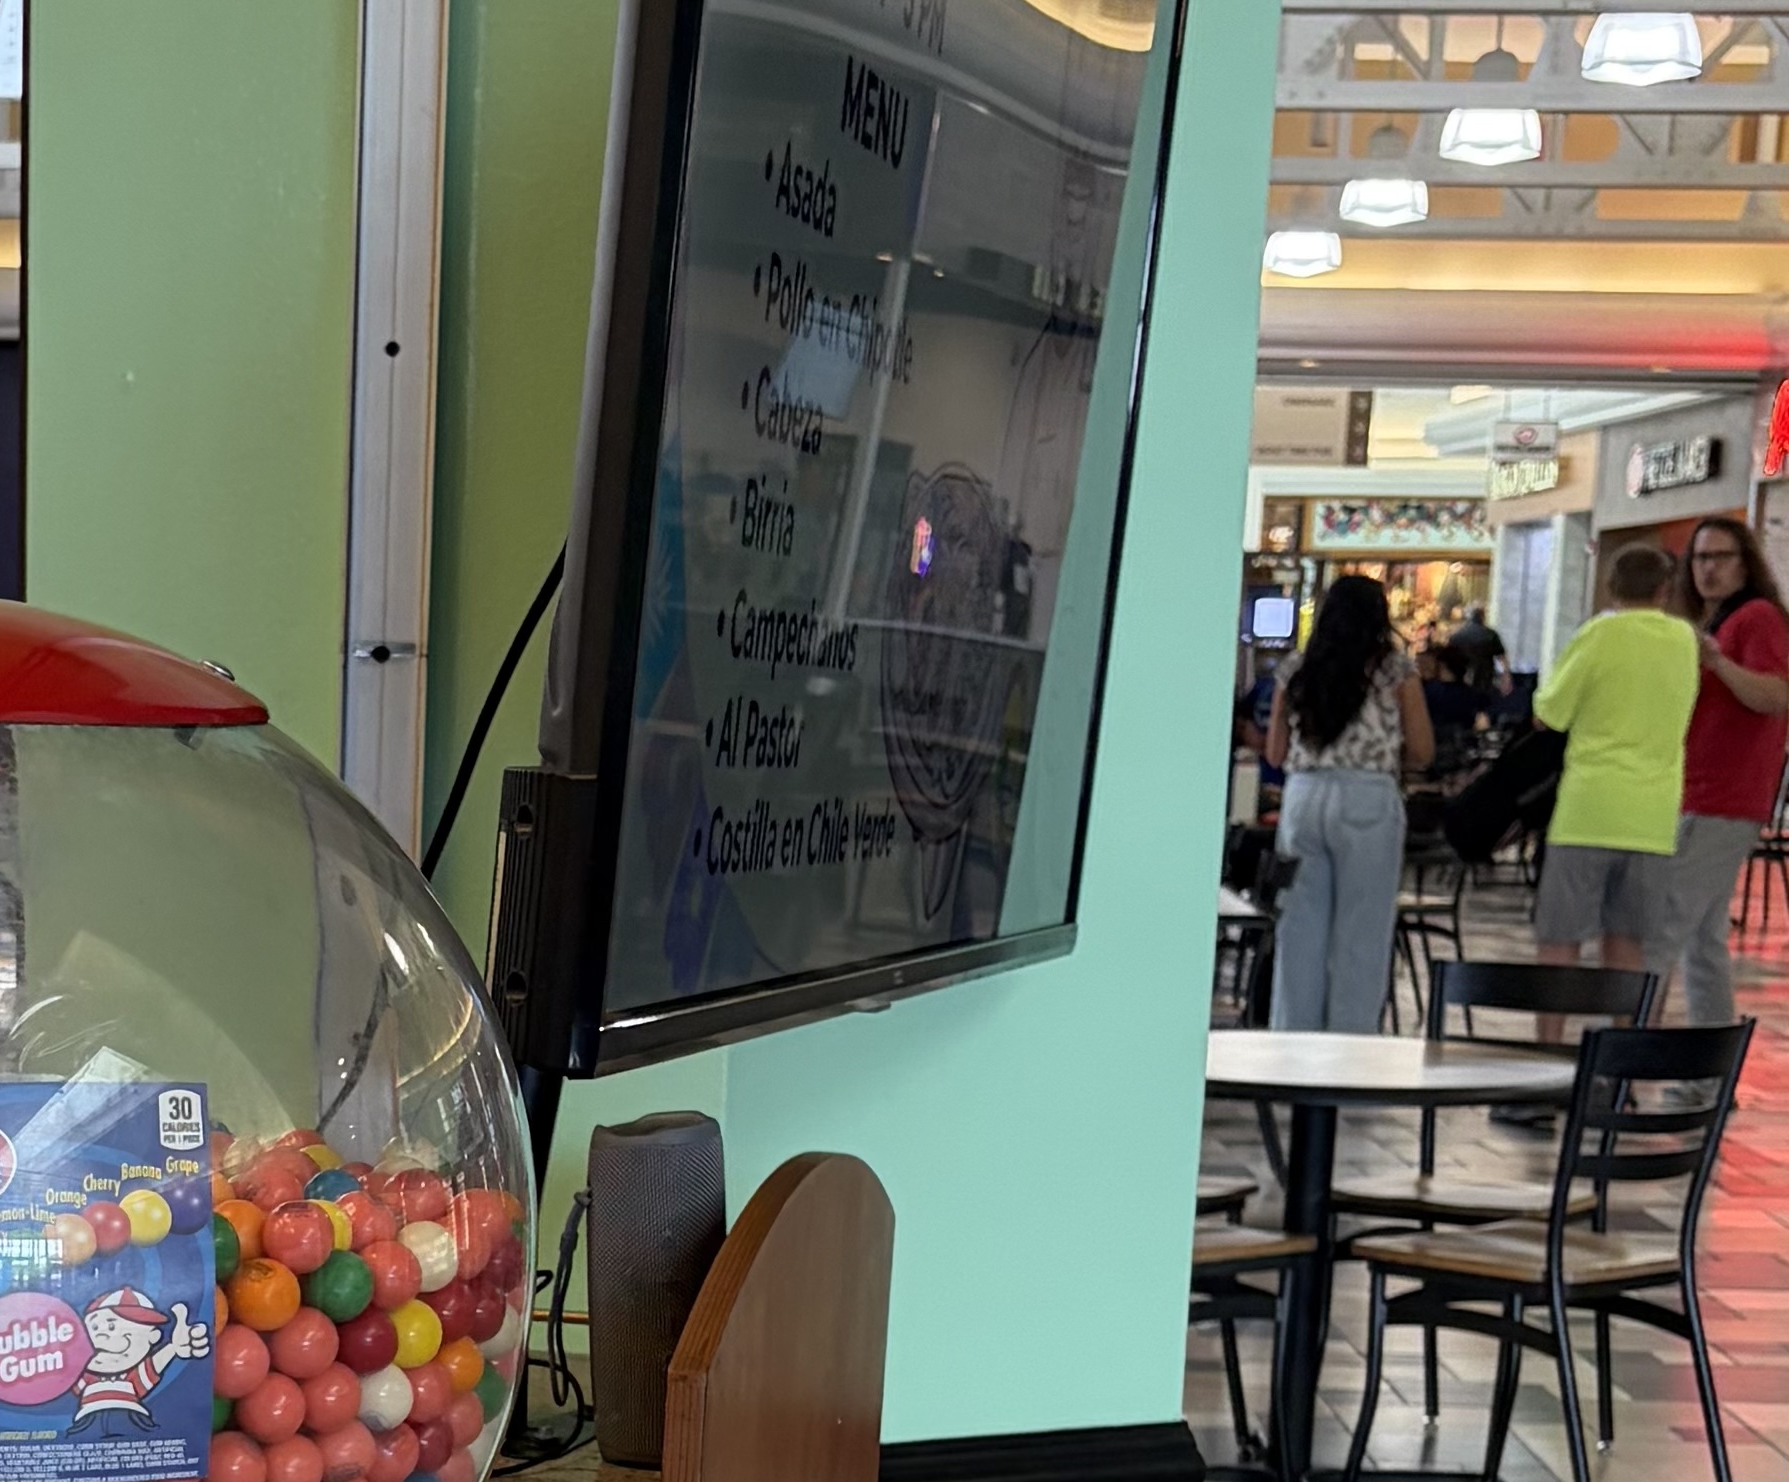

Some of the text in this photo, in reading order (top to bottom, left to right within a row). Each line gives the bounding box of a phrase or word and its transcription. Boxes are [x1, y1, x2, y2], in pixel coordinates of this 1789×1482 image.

[840, 54, 909, 170] MENU
[775, 137, 838, 240] Asada
[764, 251, 815, 338] Pollo
[819, 296, 842, 352] en
[754, 363, 823, 456] Cabeza
[741, 473, 796, 557] Birria
[729, 587, 860, 681] Campechanos
[714, 693, 805, 769] Al Pastor
[706, 795, 896, 876] Costilla en Chile Verde
[169, 1096, 193, 1120] 30
[45, 1188, 88, 1207] Orange
[83, 1173, 121, 1197] Cherry
[120, 1163, 163, 1181] Banana
[165, 1156, 200, 1175] Grape
[0, 1350, 64, 1383] Gum
